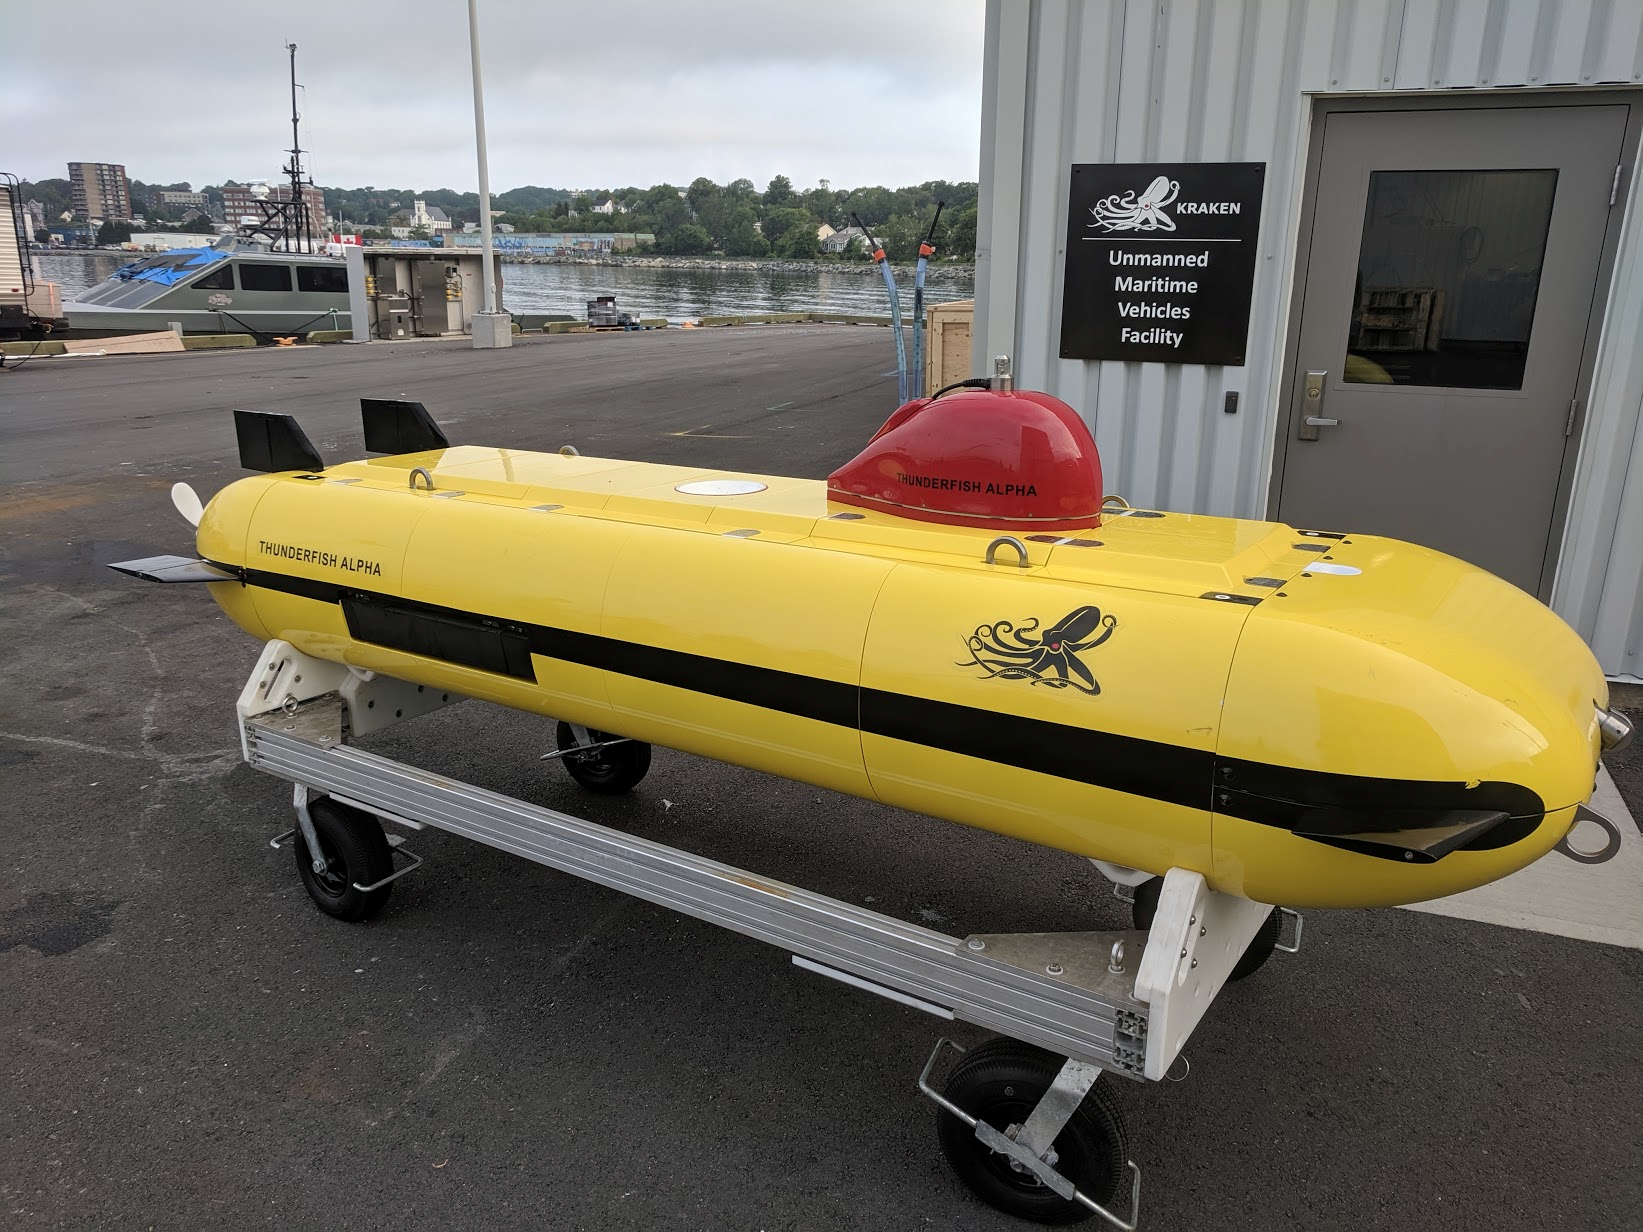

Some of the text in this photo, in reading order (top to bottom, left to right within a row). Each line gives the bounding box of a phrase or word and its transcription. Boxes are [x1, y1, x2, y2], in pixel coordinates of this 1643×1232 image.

[1176, 202, 1241, 215] KRAKEN
[1109, 250, 1209, 268] Unmanned
[1114, 276, 1198, 294] Maritime
[1118, 302, 1191, 320] Vehicles
[1121, 327, 1183, 348] Facility
[896, 472, 1037, 497] THUNDERFISH ALPHA
[259, 540, 382, 577] THUNDERFISH ALPHA
